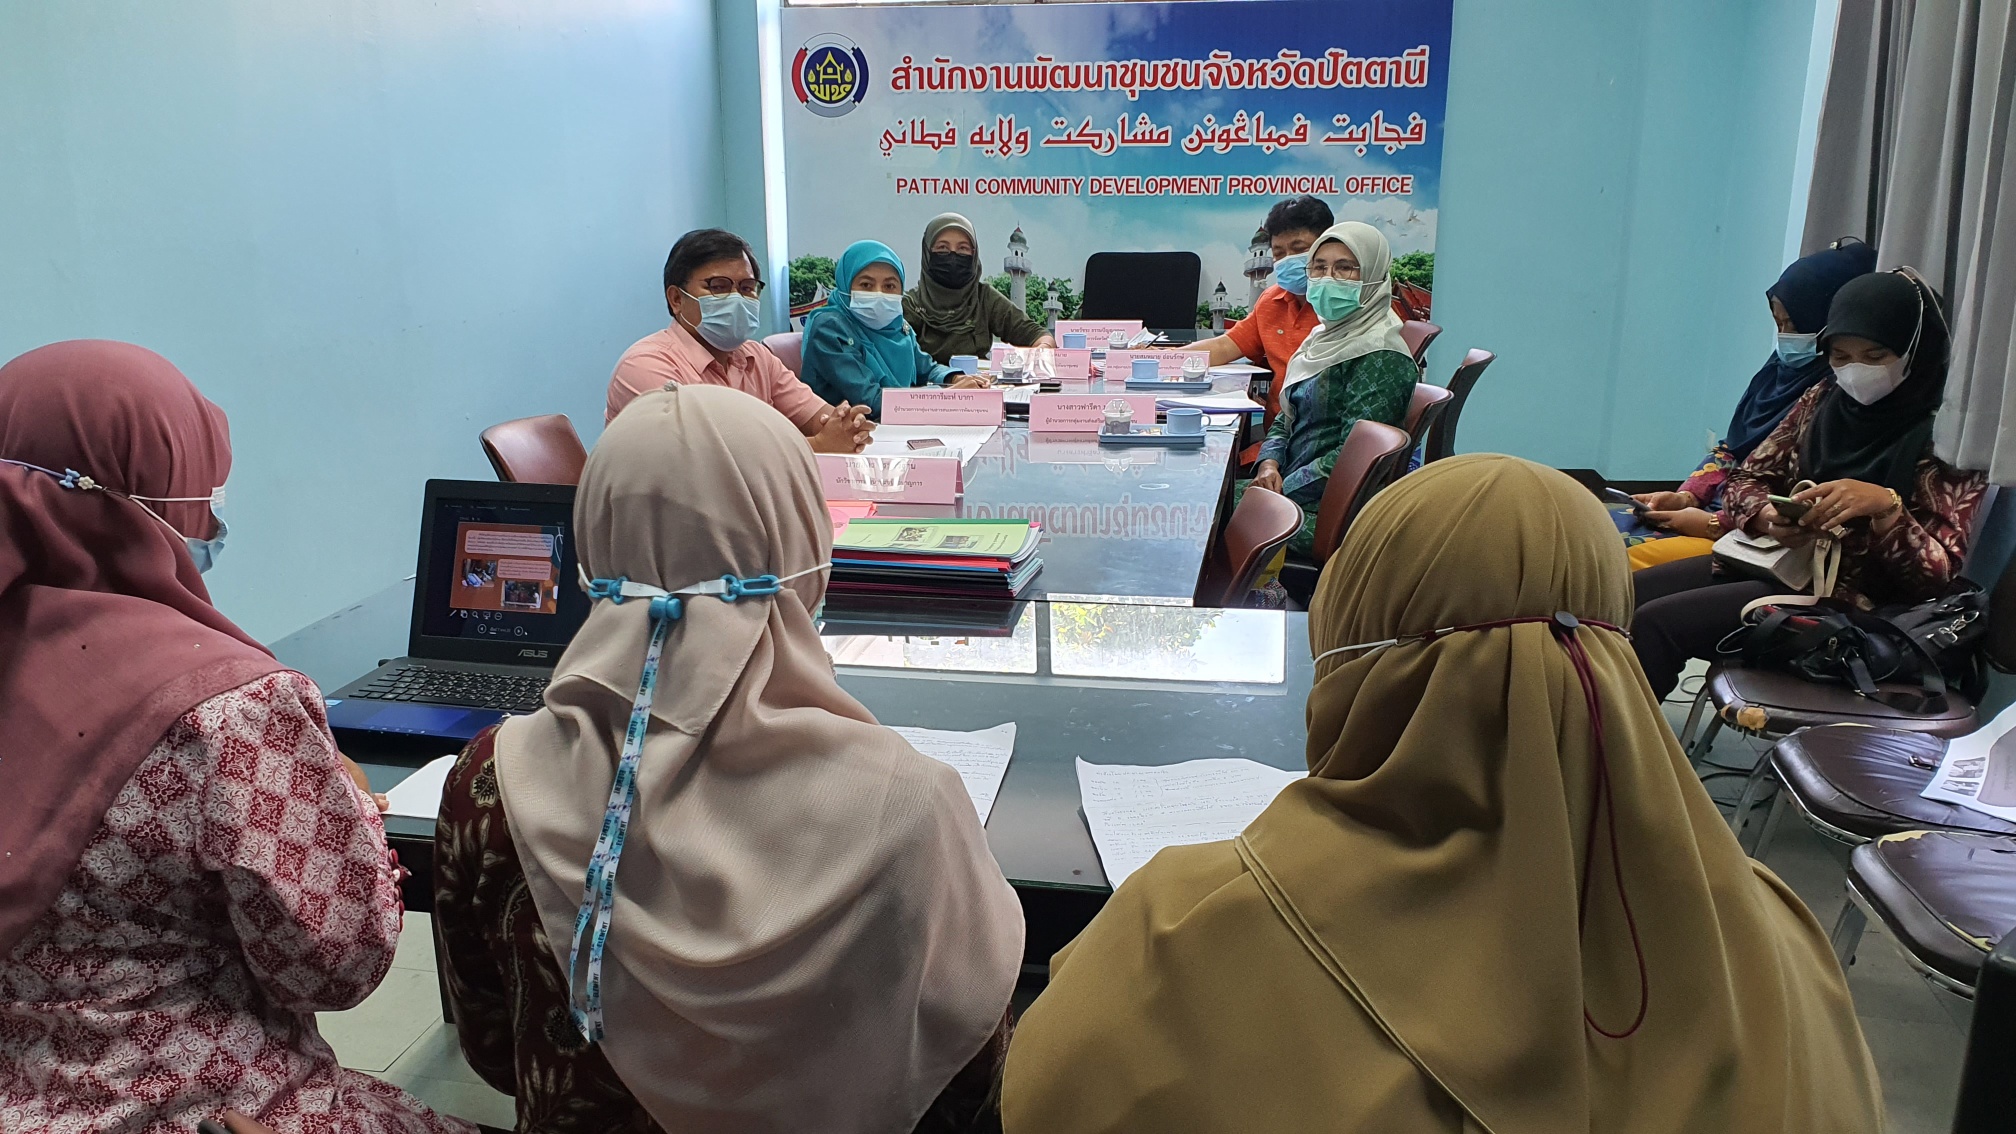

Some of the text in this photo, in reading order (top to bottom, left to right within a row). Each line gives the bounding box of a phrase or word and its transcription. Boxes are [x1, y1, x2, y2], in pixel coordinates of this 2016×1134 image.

[890, 48, 1428, 98] สำนักงานพัฒนาชุมชนจังหวัดปัตตานี
[895, 176, 1413, 195] PATTANI COMMUNITY DEVELOPMENT PROVINCIAL OFFICE
[517, 648, 549, 659] ASUS
